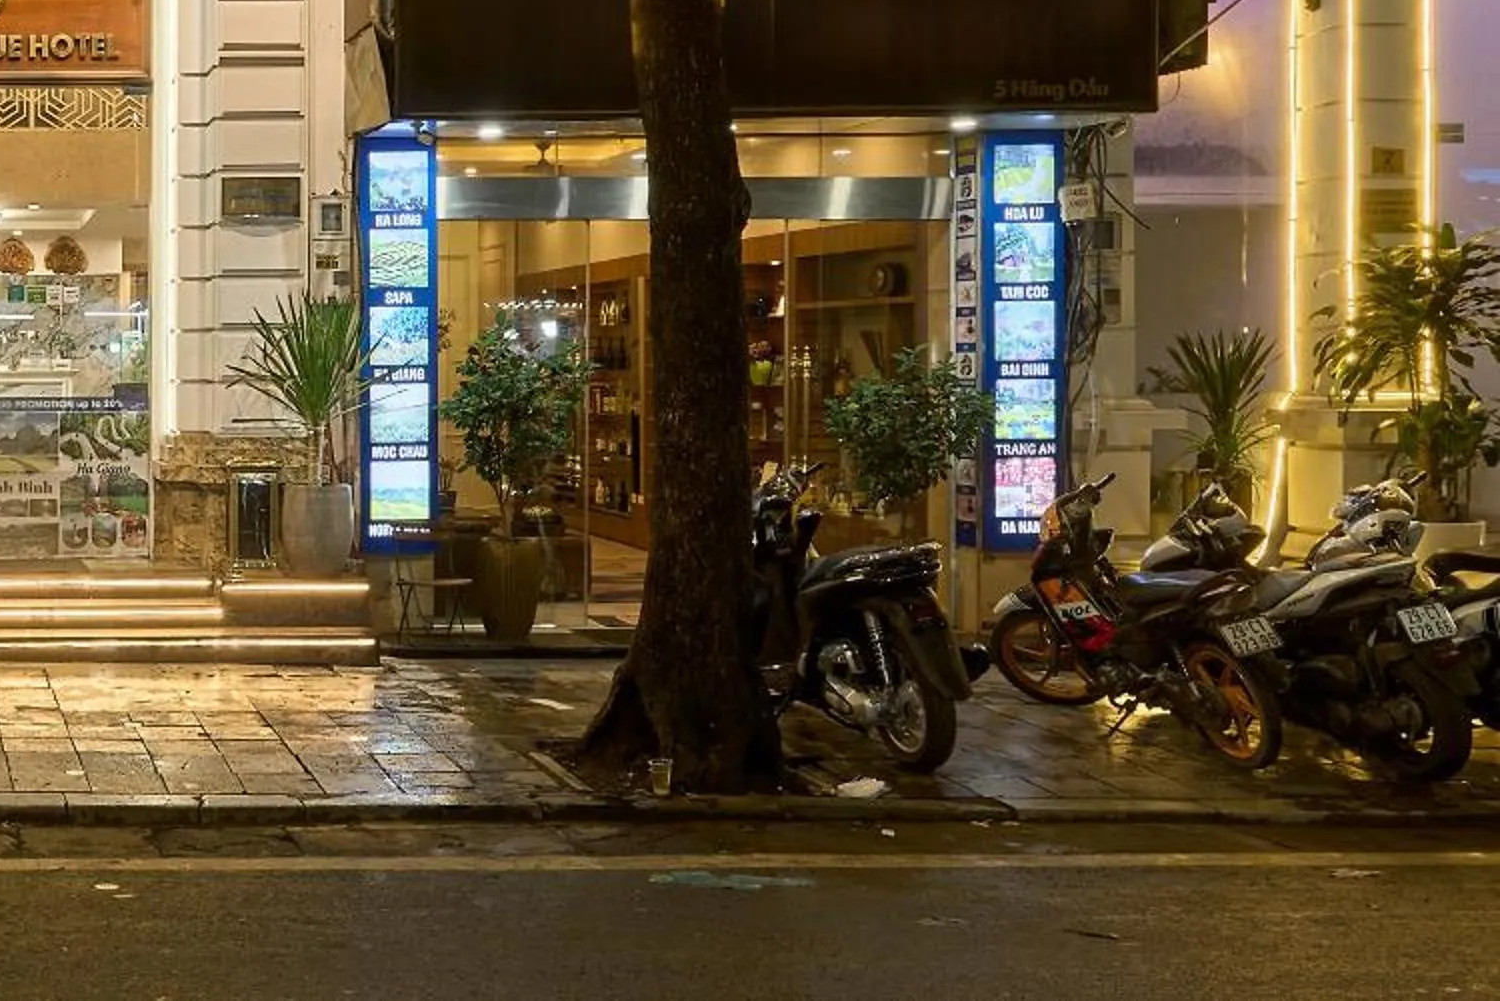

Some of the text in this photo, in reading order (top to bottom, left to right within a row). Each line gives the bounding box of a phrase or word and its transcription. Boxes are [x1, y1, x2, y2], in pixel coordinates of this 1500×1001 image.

[29, 33, 121, 62] HOTEL
[993, 80, 1006, 98] 5
[996, 442, 1056, 456] TRANG AN
